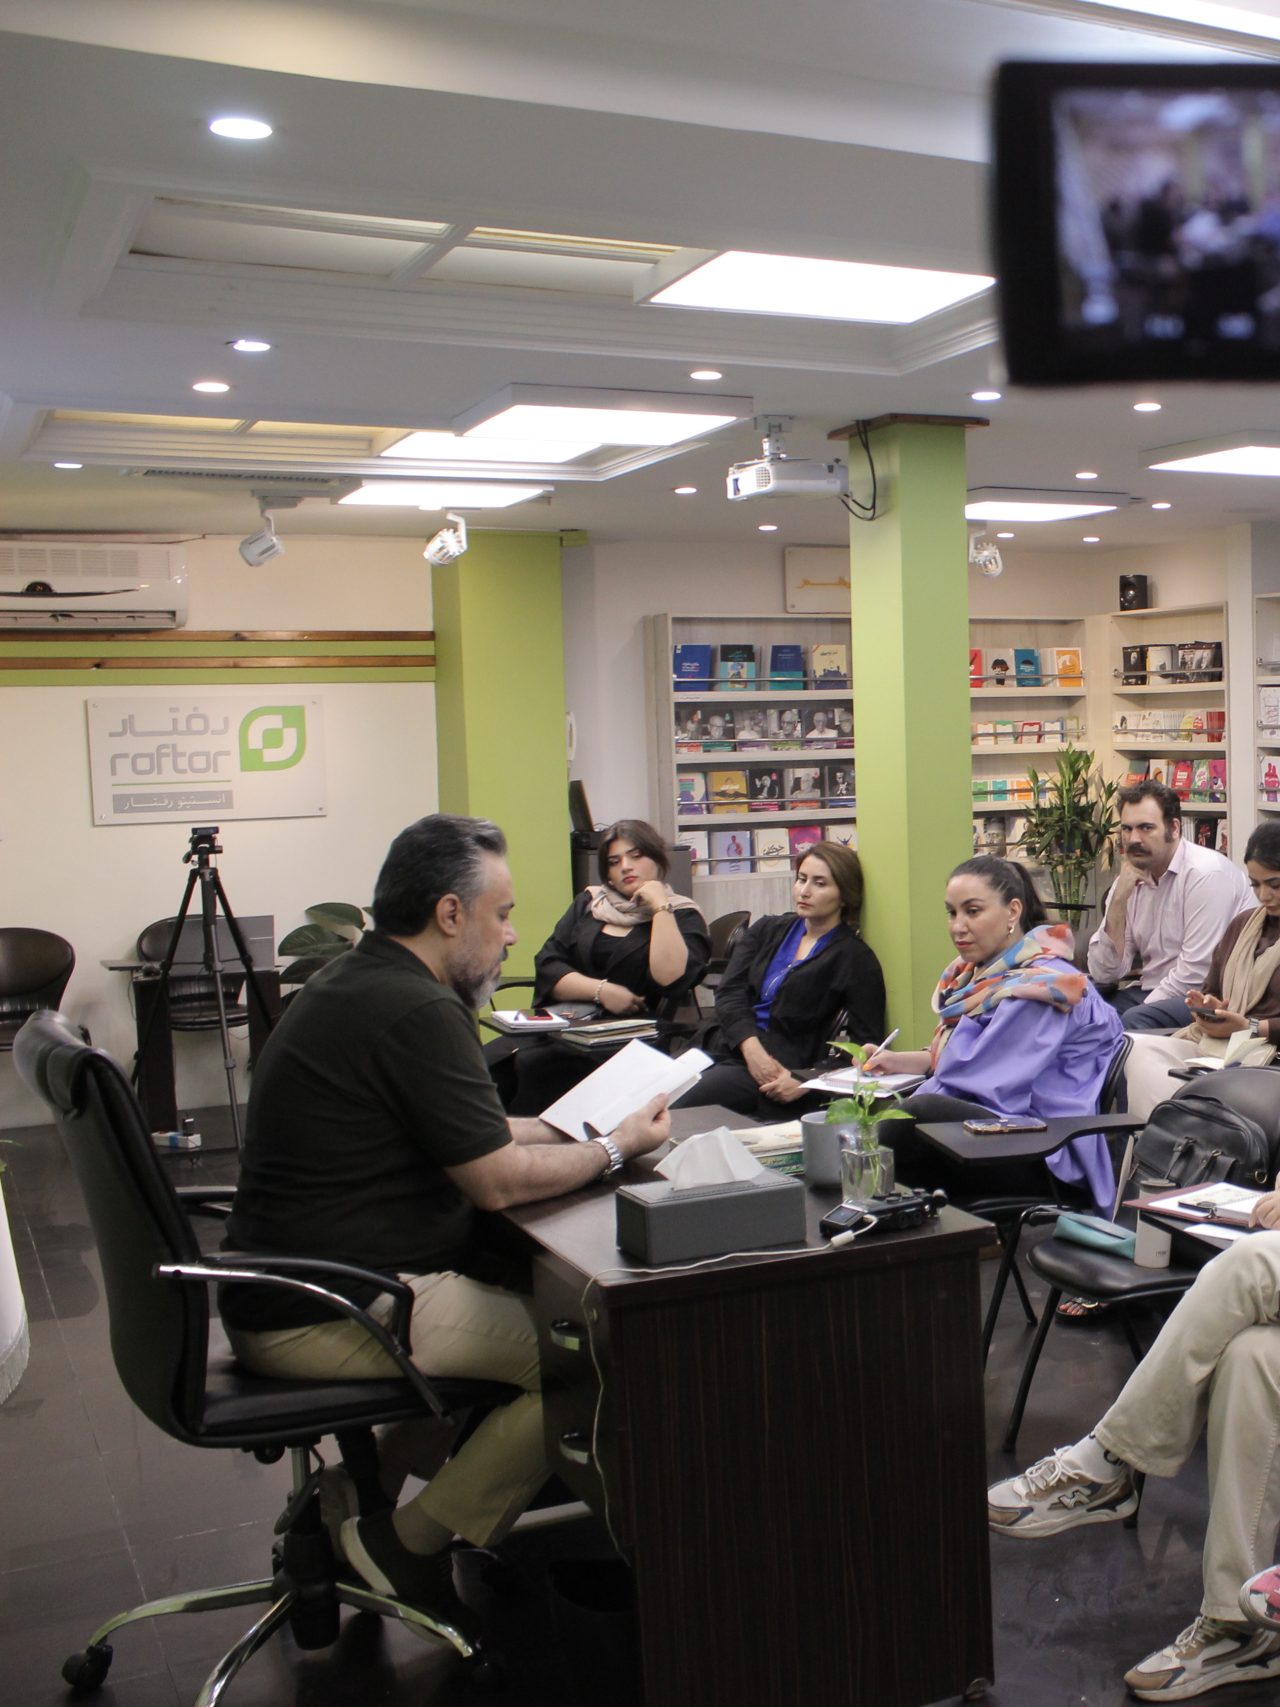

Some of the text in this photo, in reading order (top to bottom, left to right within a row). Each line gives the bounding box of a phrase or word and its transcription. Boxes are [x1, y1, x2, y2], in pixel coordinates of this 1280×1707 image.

[108, 706, 229, 738] رفتار
[110, 743, 231, 776] raftar
[123, 794, 173, 810] رفتار
